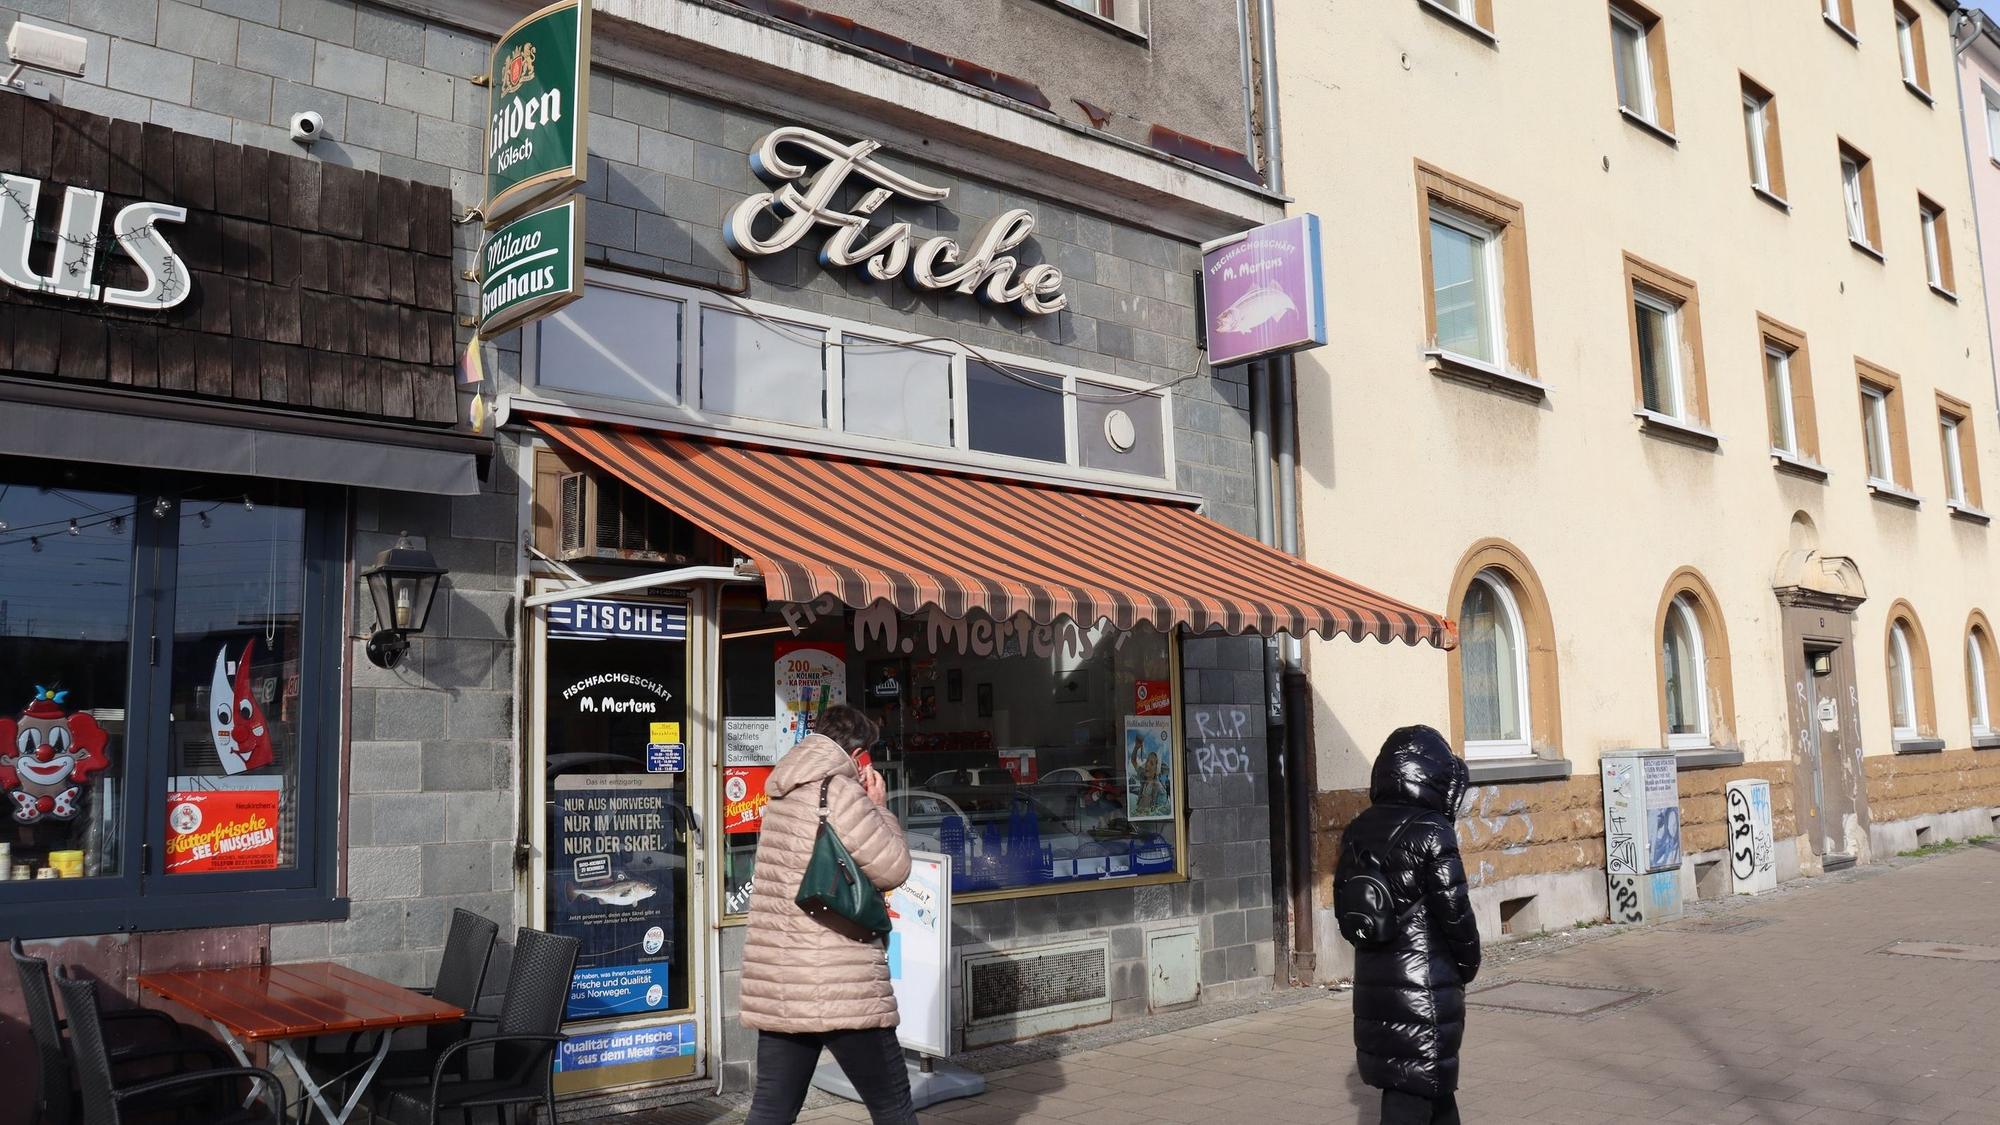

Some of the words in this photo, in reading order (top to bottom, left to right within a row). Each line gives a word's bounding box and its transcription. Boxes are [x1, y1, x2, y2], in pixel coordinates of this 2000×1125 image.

[490, 88, 561, 159] Gilden
[497, 140, 533, 174] Kölsch
[723, 126, 1067, 315] Fische
[487, 230, 542, 273] Milano
[1210, 240, 1296, 275] FISCHFACHGESCHÄFT
[1223, 267, 1238, 281] M.
[1239, 257, 1283, 277] Mertens
[482, 265, 555, 320] Brauhaus
[576, 603, 663, 632] FISCHE
[854, 602, 914, 654] M.
[927, 603, 1097, 660] Mertens
[788, 660, 810, 672] 200
[563, 673, 672, 701] FISCHFACHGESCHÄFT
[580, 696, 598, 712] M.
[601, 696, 656, 713] Mertens
[728, 722, 769, 732] Salzheringe
[728, 732, 759, 741] Salzfilets
[728, 743, 763, 752] Salzrogen
[564, 798, 585, 811] NUR
[588, 798, 607, 811] AUS
[609, 797, 665, 810] NORWEGEN.
[741, 809, 754, 822] SEE
[166, 813, 267, 854] Kutterfrische
[564, 815, 591, 832] NUR
[594, 814, 609, 831] IM
[613, 814, 665, 831] WINTER.
[192, 843, 213, 860] SEE
[219, 827, 275, 853] MUSCHELN
[564, 837, 592, 854] NUR
[595, 836, 620, 853] DER
[624, 834, 665, 852] SKREI.
[729, 875, 755, 911] Fris
[571, 980, 600, 990] Frische
[603, 979, 619, 987] und
[620, 975, 652, 985] Qualität
[627, 968, 653, 976] schmeckt:
[587, 988, 631, 999] Norwegen.
[563, 1038, 609, 1054] Qualität
[611, 1034, 633, 1048] und
[635, 1031, 673, 1045] Frische
[577, 1054, 597, 1065] aus
[600, 1050, 625, 1062] dem
[627, 1045, 655, 1058] Meer
